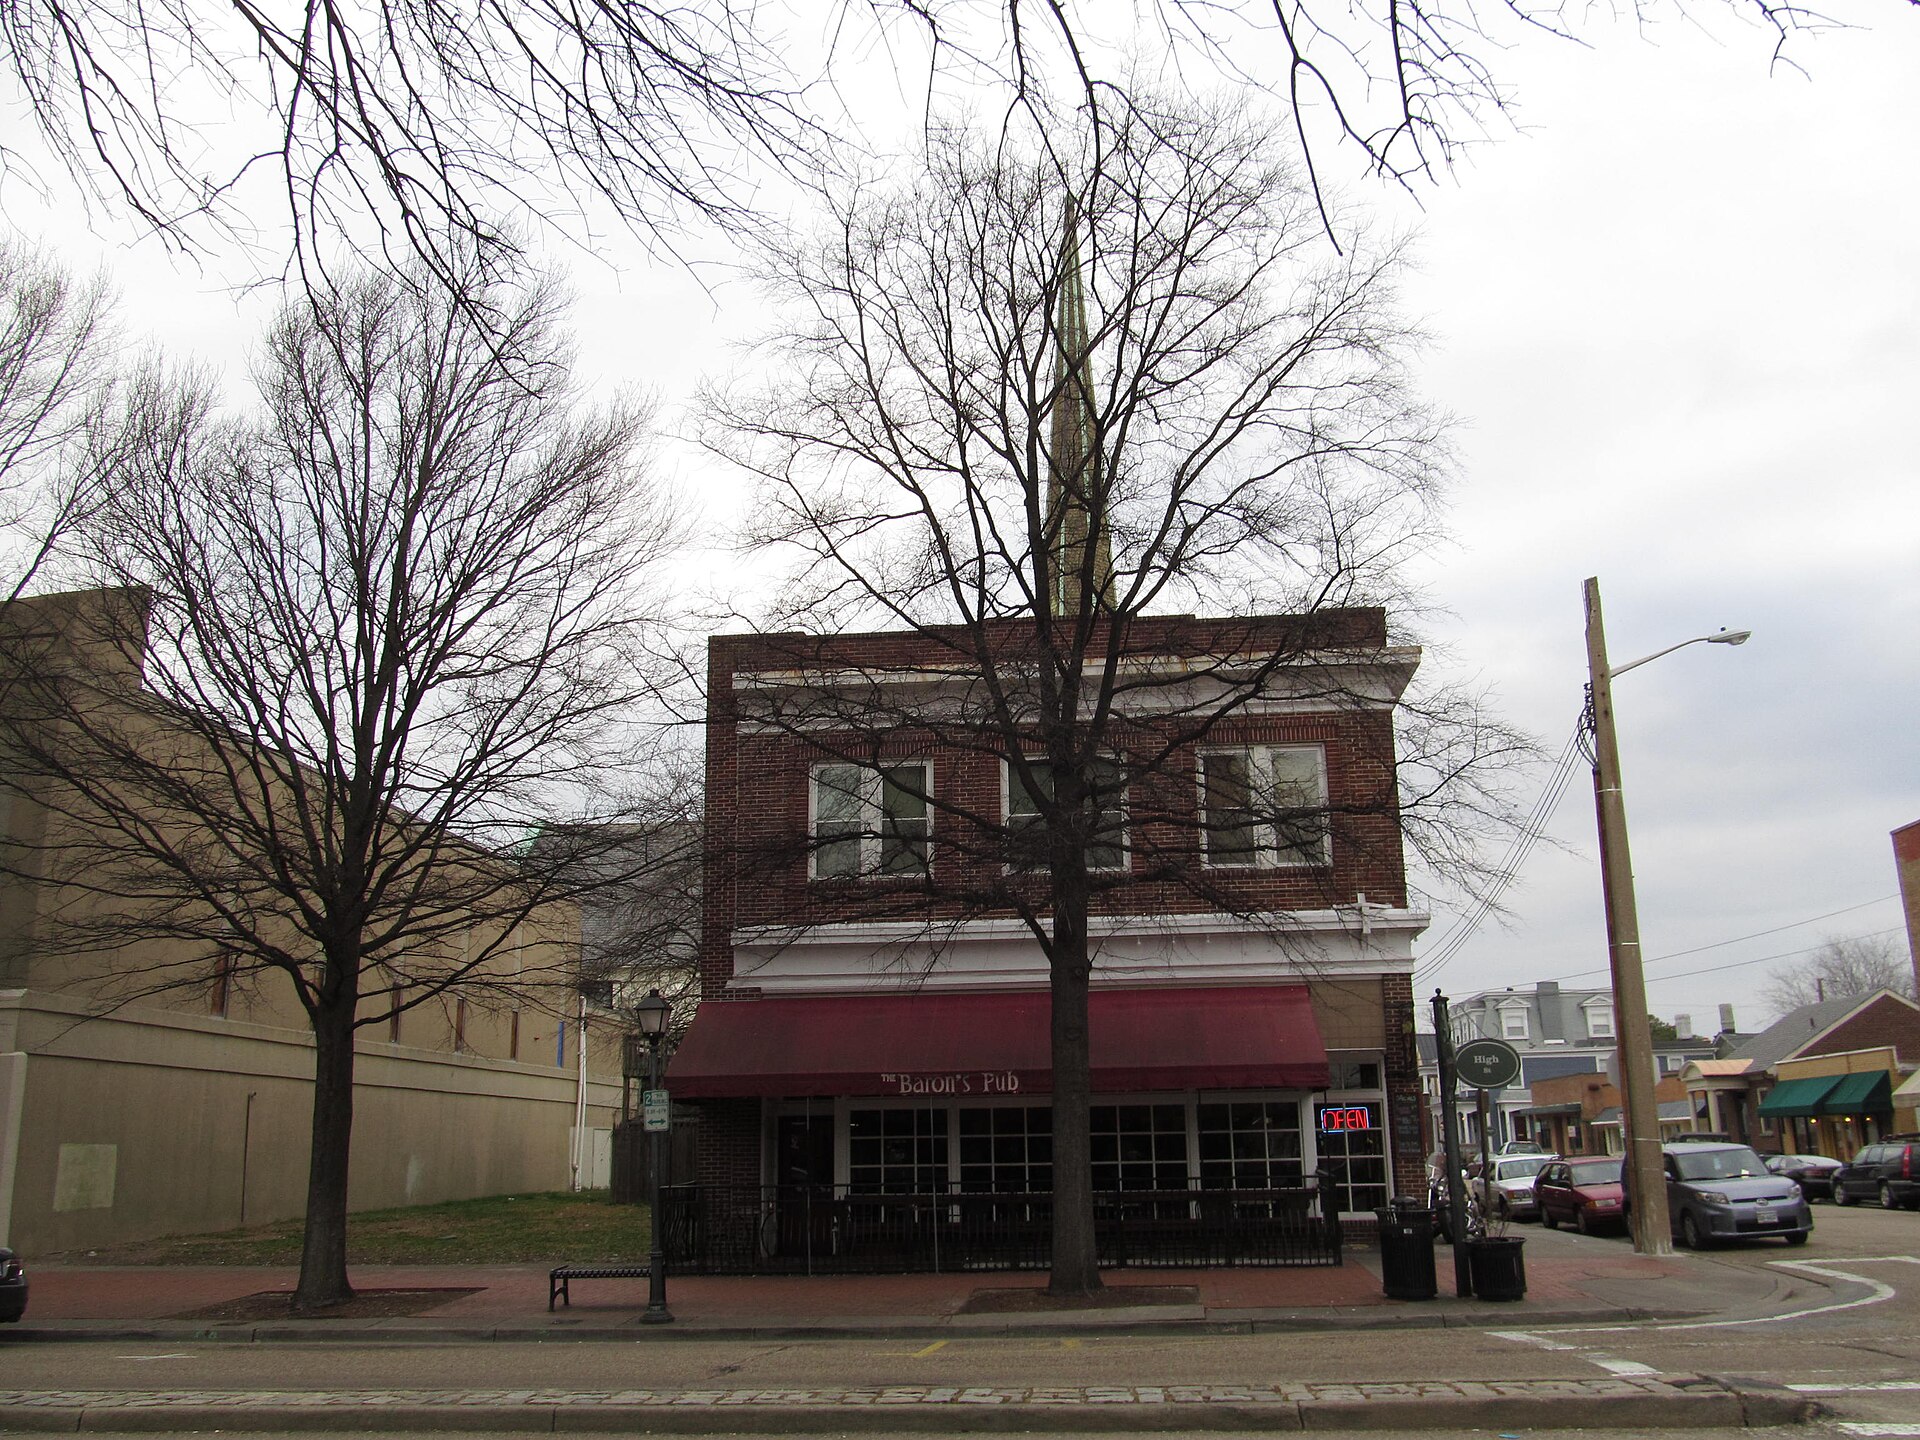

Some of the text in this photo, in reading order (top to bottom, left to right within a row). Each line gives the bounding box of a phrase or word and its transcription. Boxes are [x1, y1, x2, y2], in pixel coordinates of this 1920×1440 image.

[1474, 1055, 1499, 1065] High
[881, 1071, 1019, 1094] THE Baron's Pub
[645, 1093, 652, 1105] 2
[1323, 1110, 1367, 1130] OPEN
